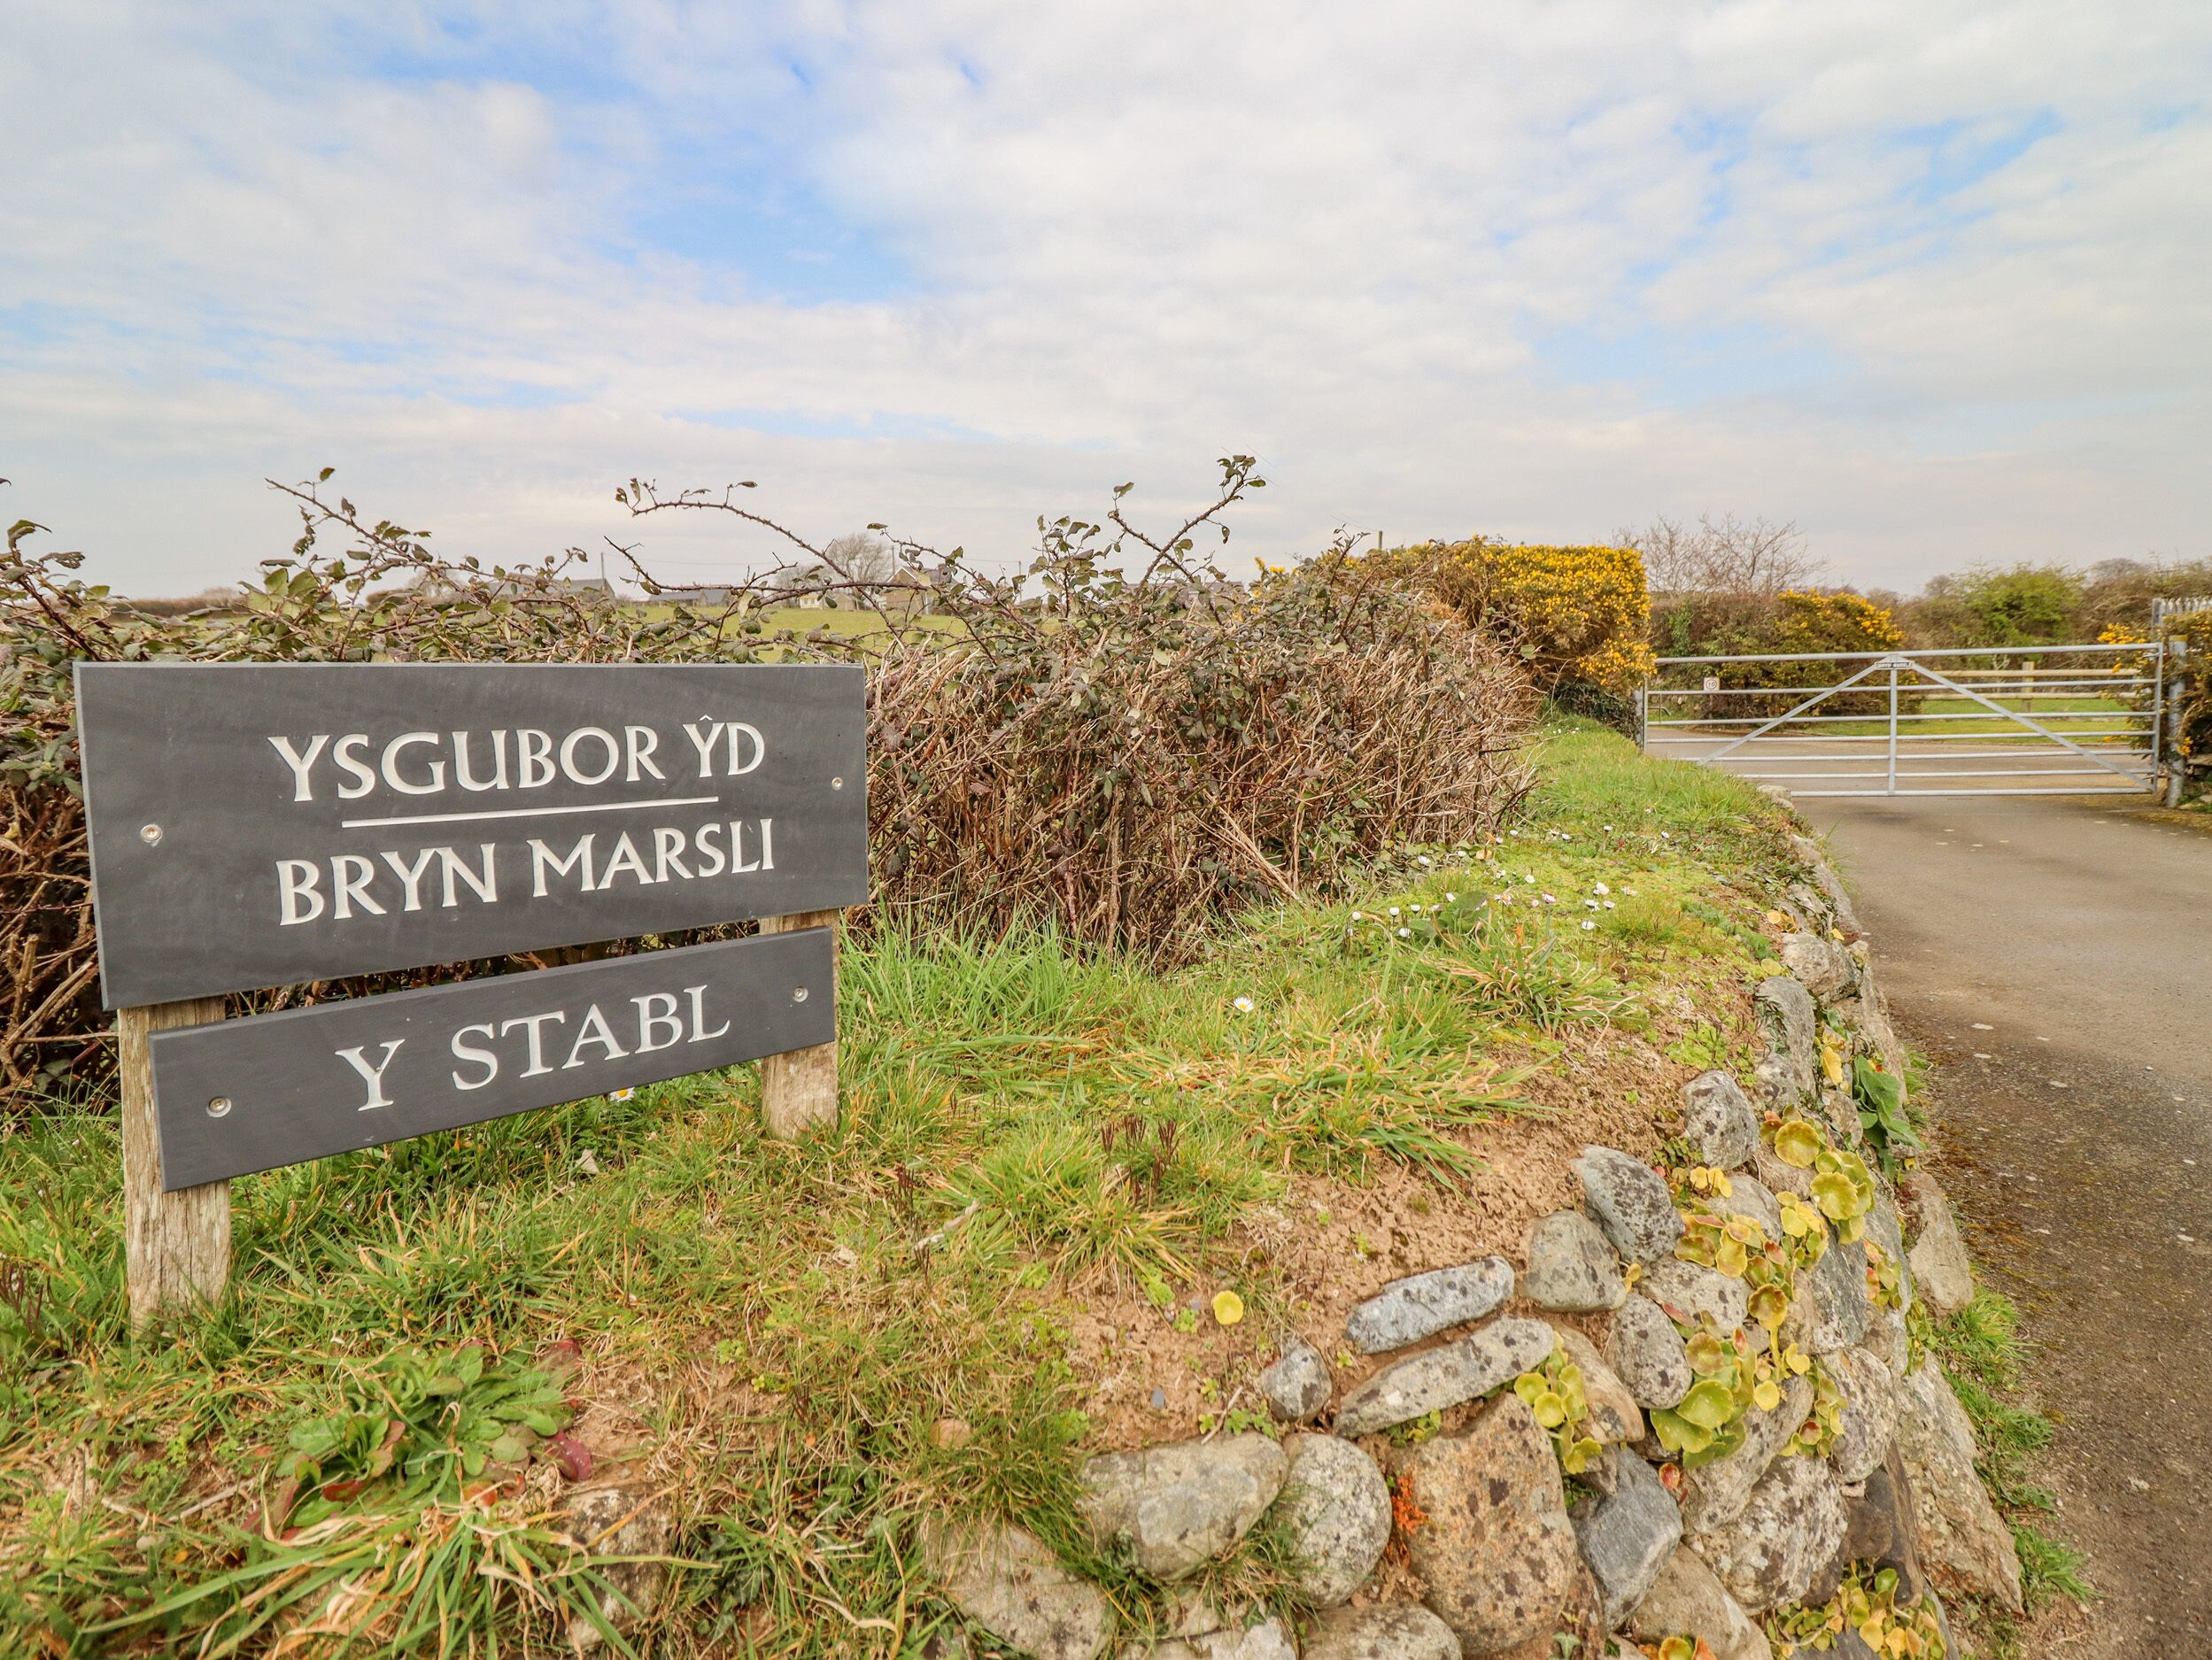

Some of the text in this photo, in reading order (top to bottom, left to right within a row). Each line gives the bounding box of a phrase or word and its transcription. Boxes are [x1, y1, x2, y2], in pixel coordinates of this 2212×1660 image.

[267, 714, 764, 801] YSGUBOR ŶD
[276, 818, 776, 925] BRYN MARSLI
[335, 984, 731, 1111] Y STABL
